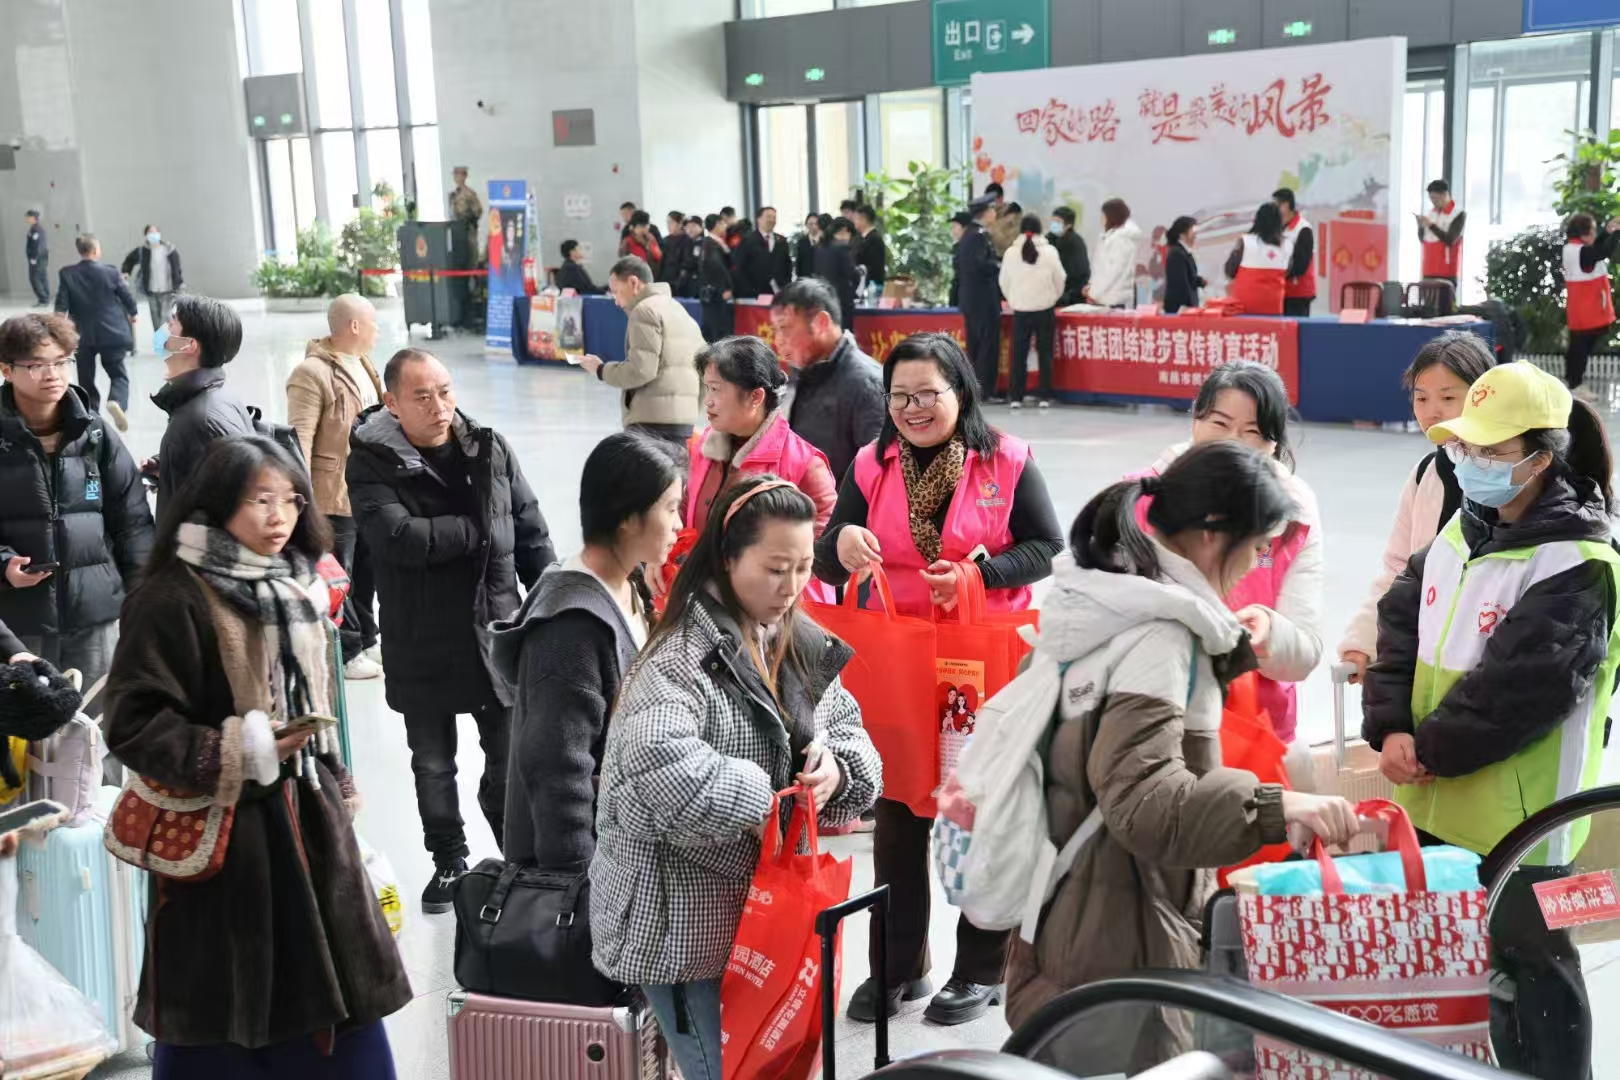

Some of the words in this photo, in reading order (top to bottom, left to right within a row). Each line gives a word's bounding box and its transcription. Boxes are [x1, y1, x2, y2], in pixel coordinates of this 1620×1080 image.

[944, 20, 980, 45] 出口
[1016, 98, 1121, 146] 回家的路
[1138, 73, 1332, 146] 就是最美的风景
[731, 944, 777, 978] 园酒店
